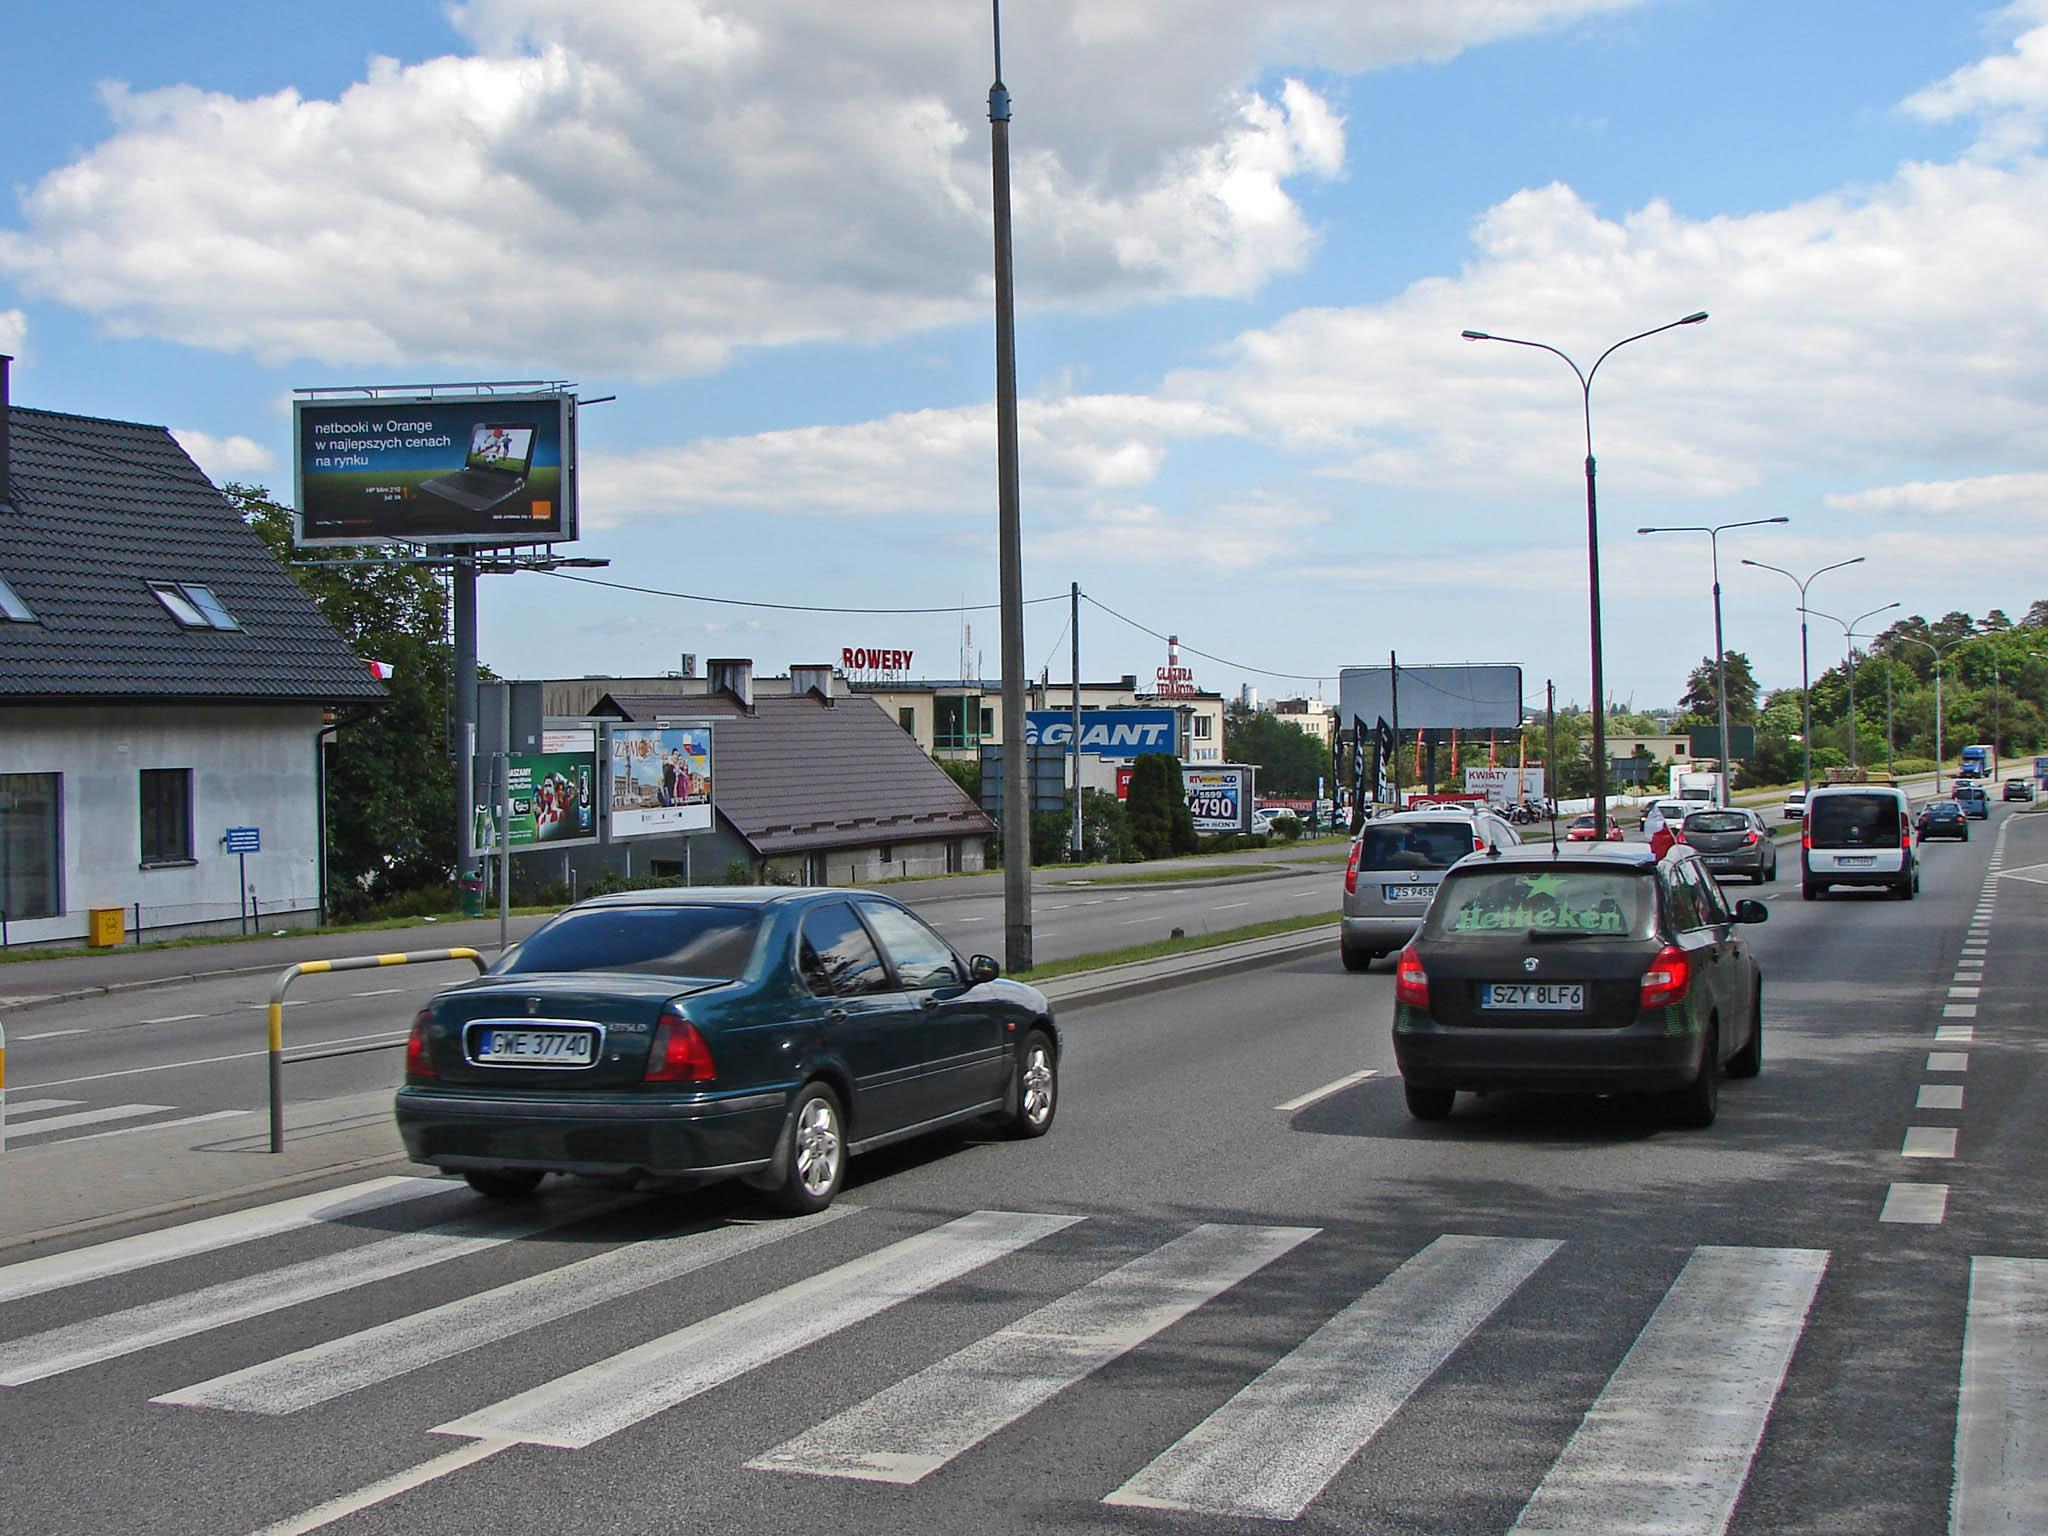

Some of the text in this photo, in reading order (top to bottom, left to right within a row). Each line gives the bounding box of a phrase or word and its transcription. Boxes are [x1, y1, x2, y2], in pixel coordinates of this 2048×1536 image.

[315, 420, 433, 434] netbooki w Orange
[315, 435, 451, 452] w najlepszych cenach
[315, 454, 369, 469] na rynku
[842, 648, 913, 670] ROWERY
[1156, 667, 1193, 681] GLAZURA
[1041, 723, 1169, 745] GIANT
[1468, 771, 1508, 780] KWIATY
[1190, 798, 1232, 817] 4790
[1456, 901, 1623, 932] Heineken
[1493, 986, 1581, 1004] SZY 8LF6
[493, 1033, 589, 1056] GWE 37740
